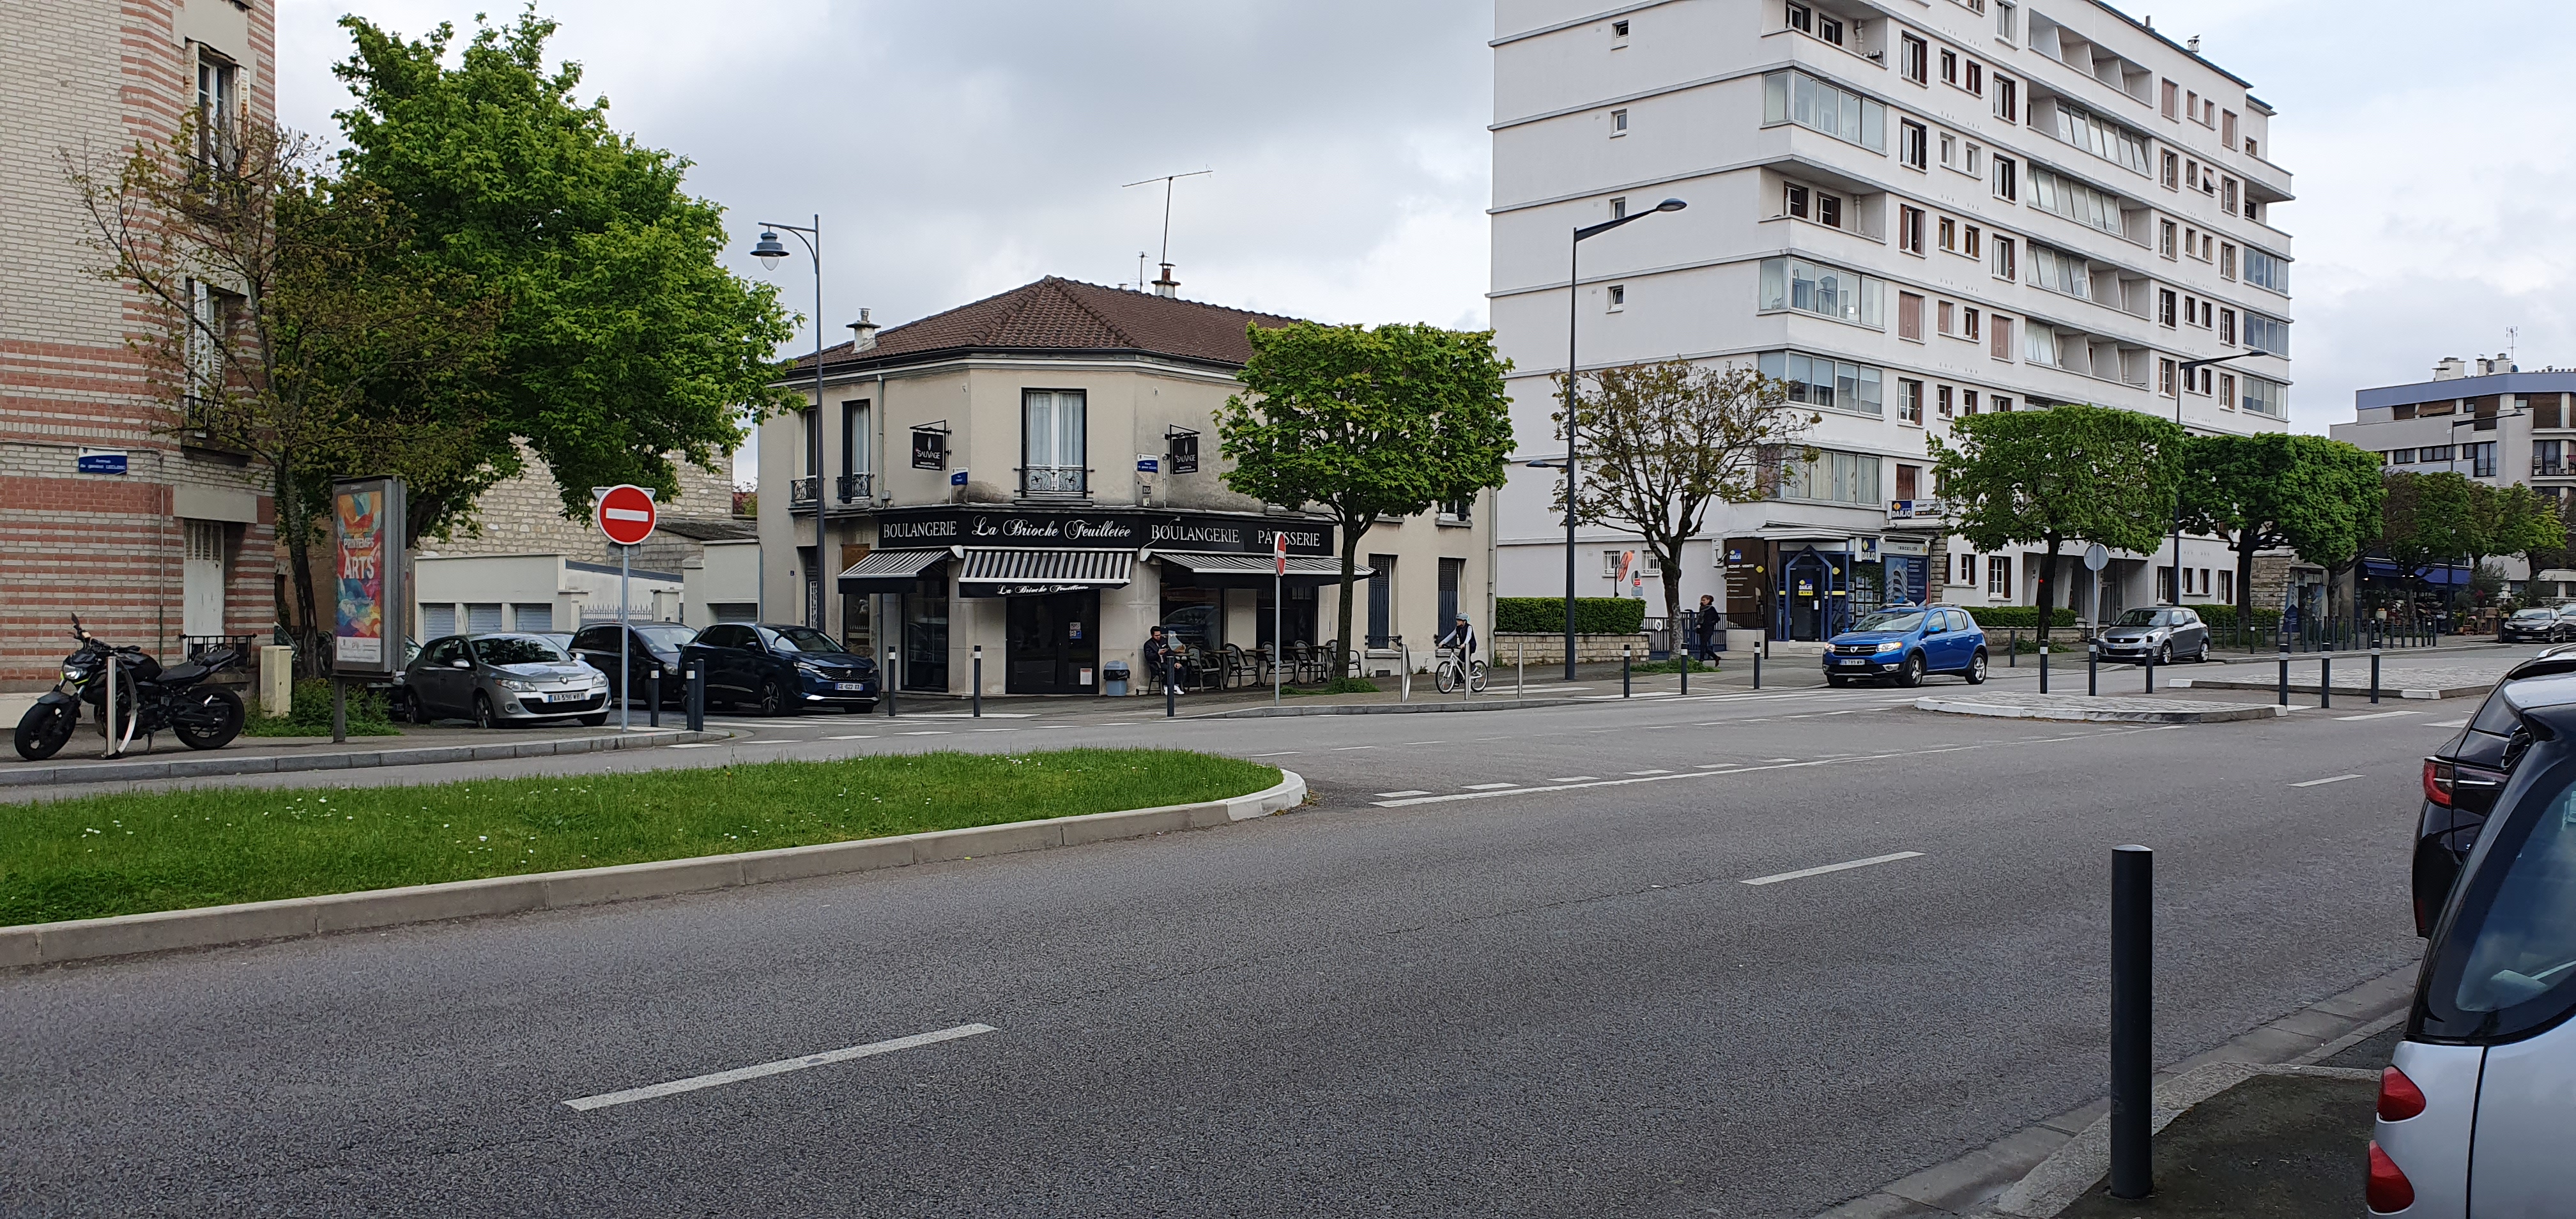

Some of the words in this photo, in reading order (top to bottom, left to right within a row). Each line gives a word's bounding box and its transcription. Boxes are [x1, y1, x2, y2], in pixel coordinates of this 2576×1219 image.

[917, 450, 940, 459] SAUVAGE
[1176, 454, 1196, 463] SAUVAGE
[884, 521, 956, 538] BOULANGERIE
[972, 515, 999, 535] La
[1003, 519, 1059, 536] Brioche
[1064, 519, 1131, 539] Feuilletée
[1151, 525, 1239, 543] BOULANGERIE
[1257, 528, 1320, 546] PÂTSSERIE
[1862, 551, 1876, 560] DARJO
[344, 556, 375, 579] ARTS
[997, 585, 1013, 594] La
